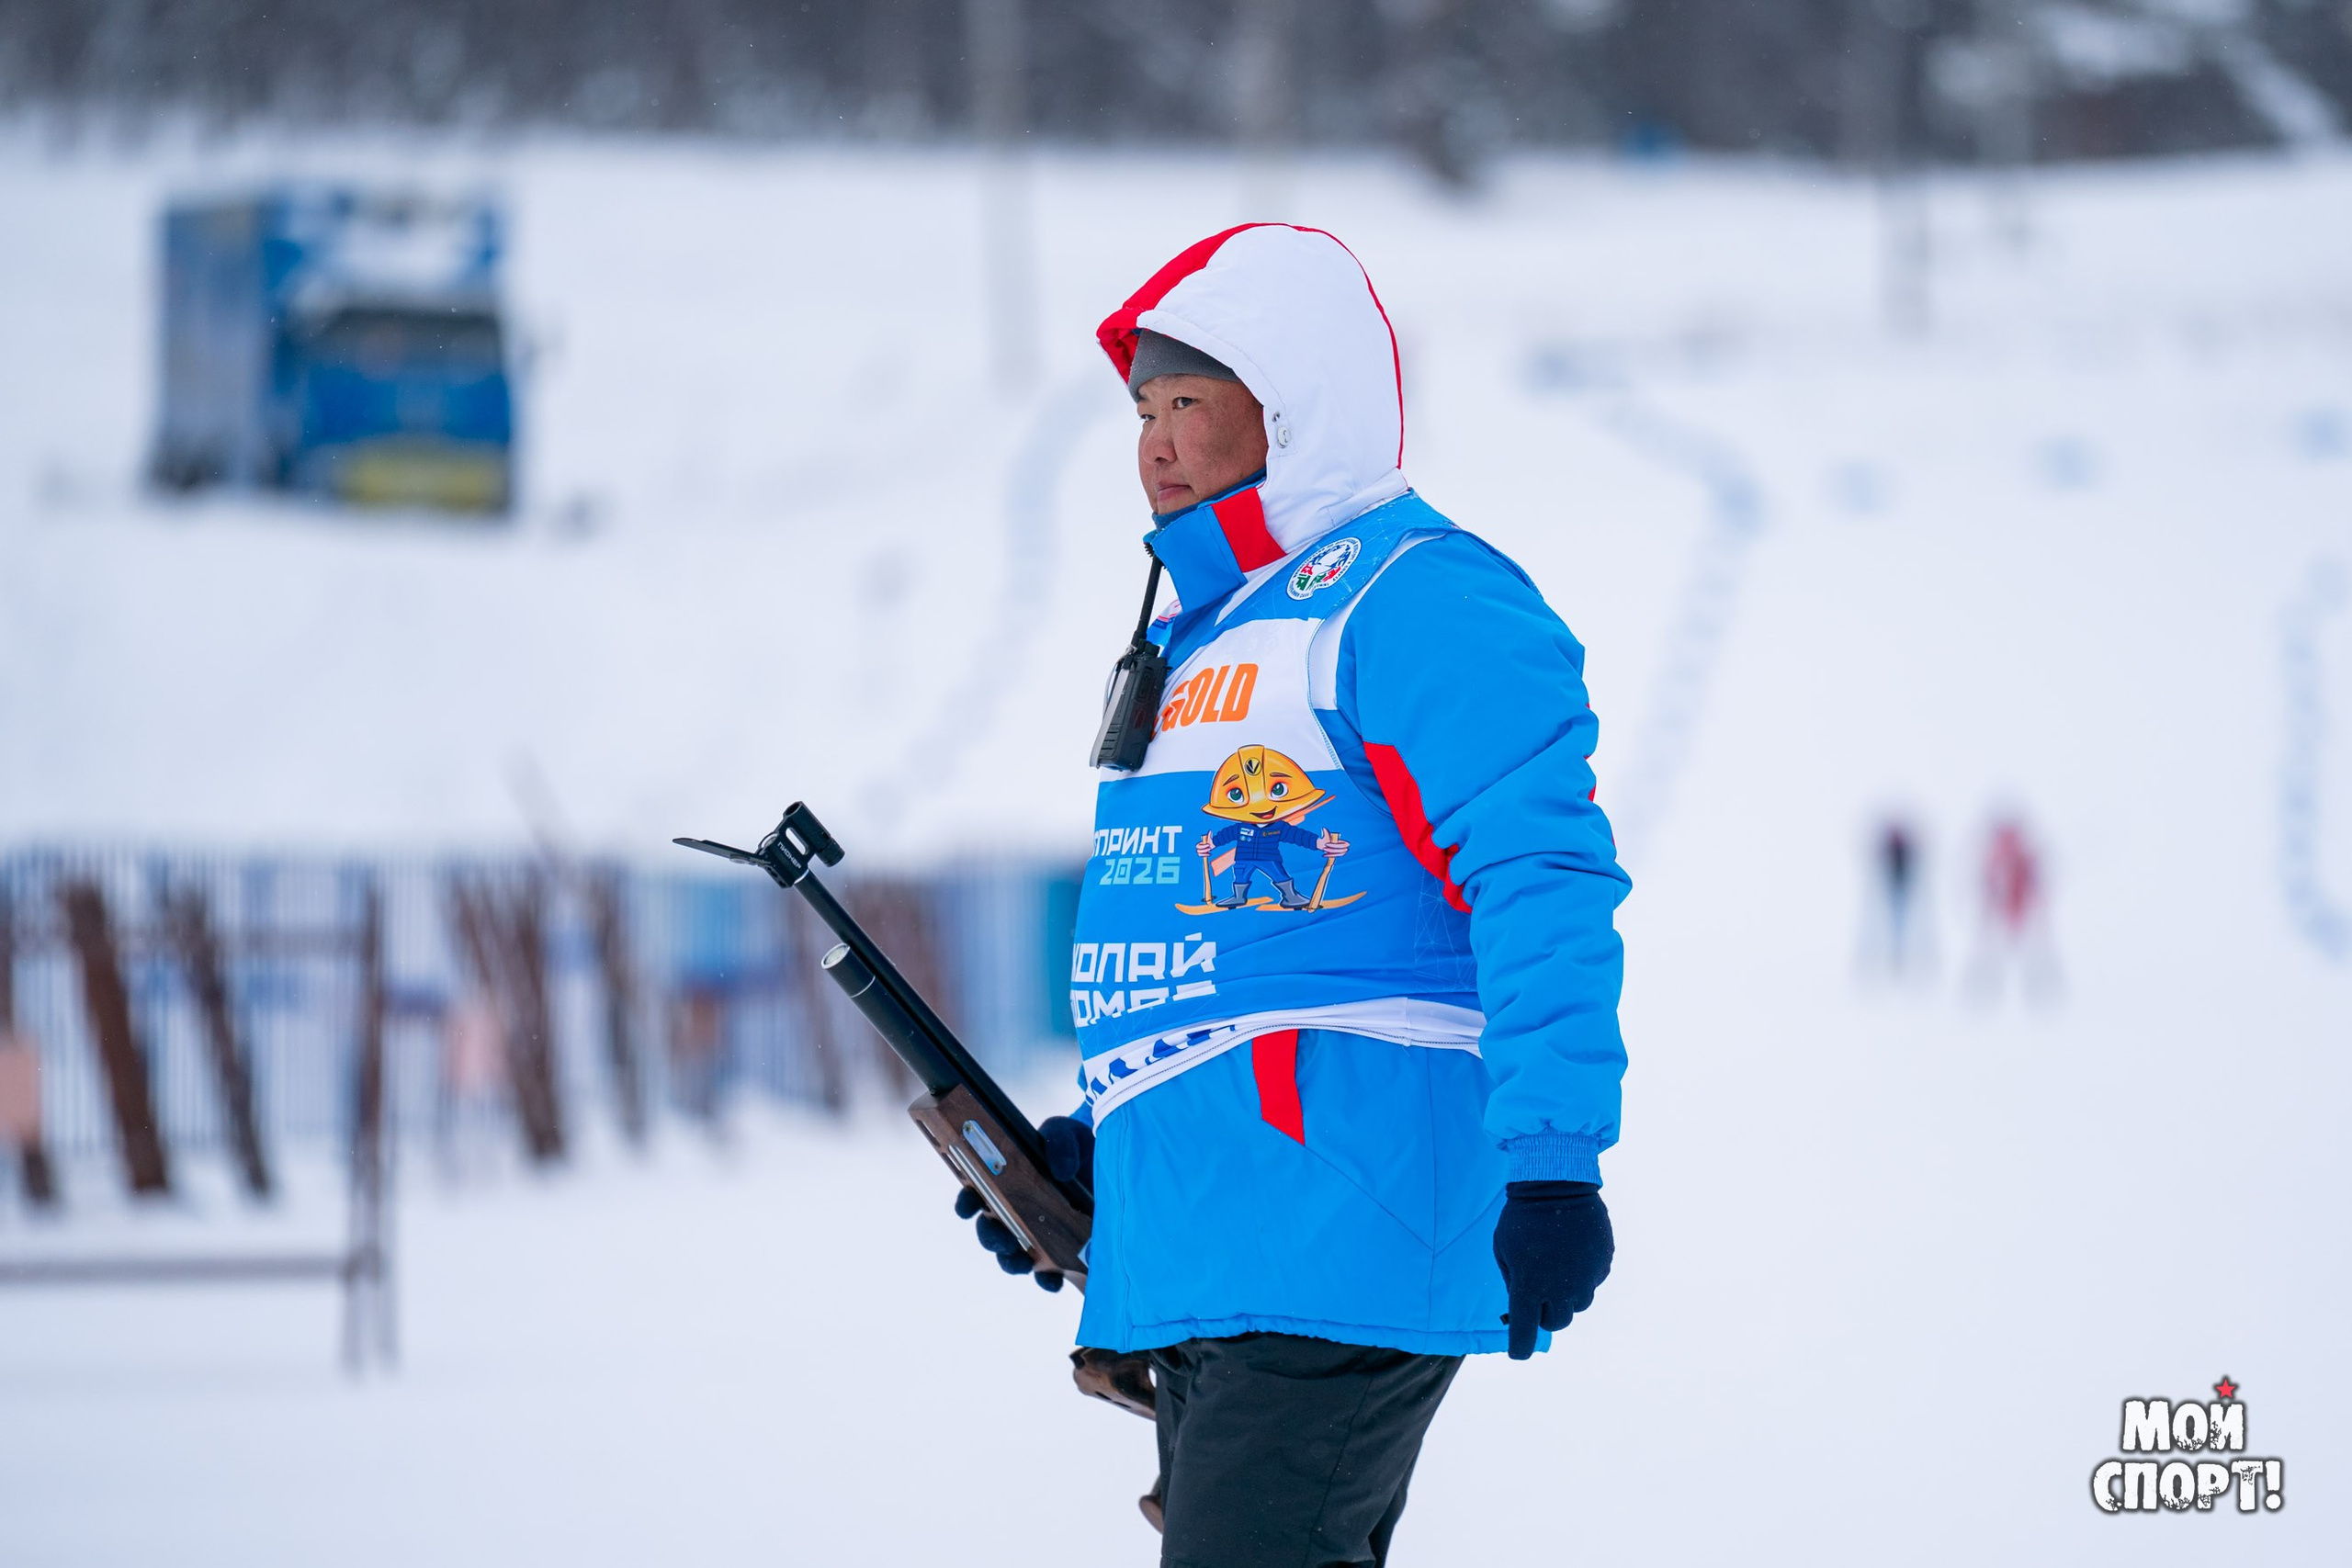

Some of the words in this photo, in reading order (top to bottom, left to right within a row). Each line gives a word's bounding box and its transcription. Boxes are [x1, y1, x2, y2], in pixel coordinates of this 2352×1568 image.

[777, 841, 802, 869] ПИОНЕР
[1093, 826, 1182, 857] ПРИНТ
[1099, 856, 1181, 886] 2026
